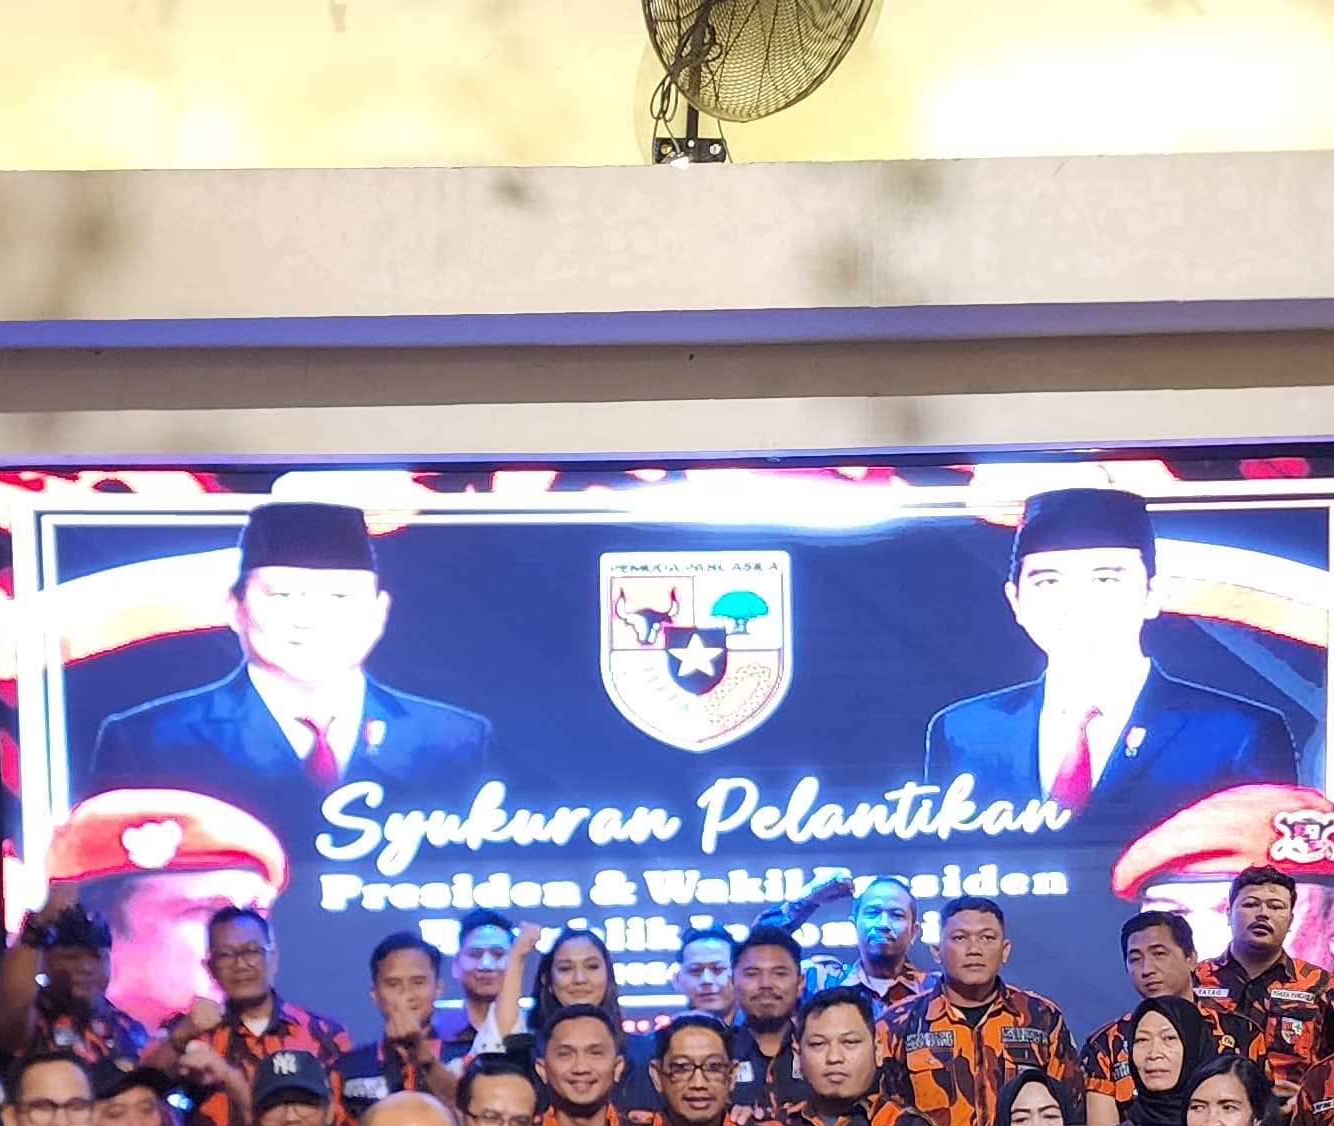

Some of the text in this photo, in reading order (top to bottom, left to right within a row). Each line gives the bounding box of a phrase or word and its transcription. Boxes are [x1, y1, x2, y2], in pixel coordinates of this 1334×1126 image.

[315, 773, 1071, 877] Syukuran Pelantikan
[319, 872, 582, 911] Presiden
[589, 869, 637, 906] &
[642, 867, 804, 904] Wakil
